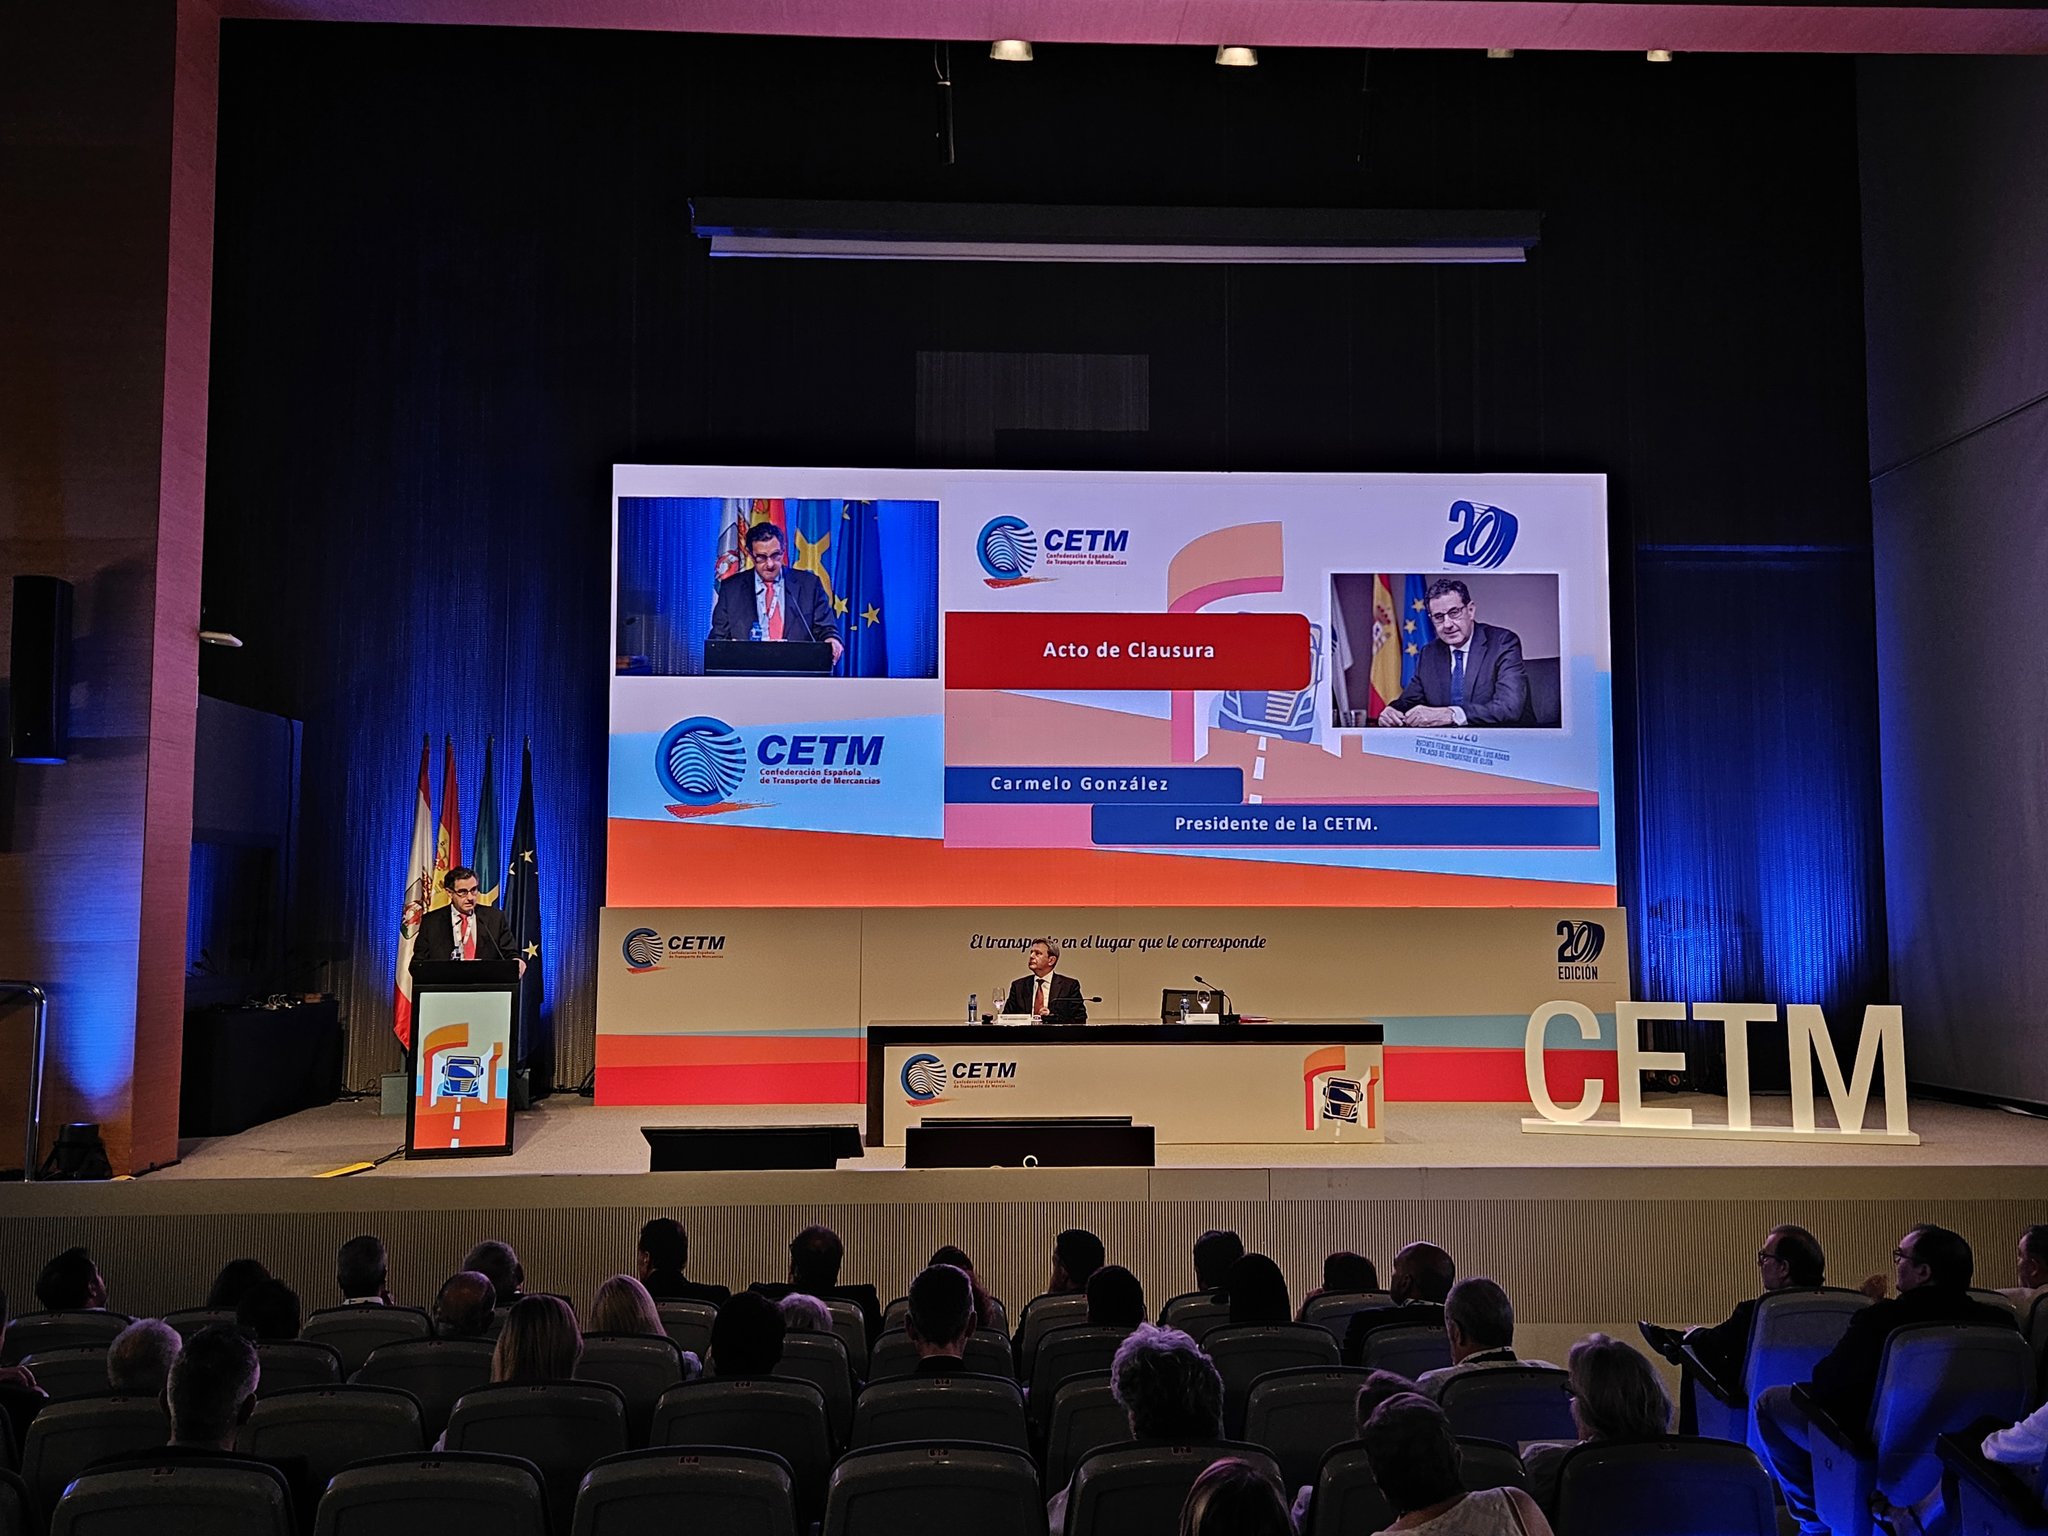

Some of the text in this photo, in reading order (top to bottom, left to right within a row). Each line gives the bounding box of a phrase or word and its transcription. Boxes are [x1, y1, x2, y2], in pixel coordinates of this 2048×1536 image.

[1044, 529, 1129, 551] CETM
[1443, 500, 1518, 569] 20
[1043, 641, 1215, 658] Acto de Clausura
[757, 734, 885, 766] CETM
[760, 768, 861, 777] Confederación Española
[760, 777, 881, 786] de Transporte de Mercancías
[991, 776, 1168, 791] Carmelo González
[1175, 816, 1378, 831] Presidente de la CETM.
[668, 936, 726, 950] CETM
[970, 934, 1267, 953] El transp en el lugar que le corresponde
[1556, 920, 1606, 963] 20
[1558, 964, 1598, 980] EDICIÓN
[952, 1062, 1017, 1079] CETM
[1524, 1000, 1909, 1135] CETM
